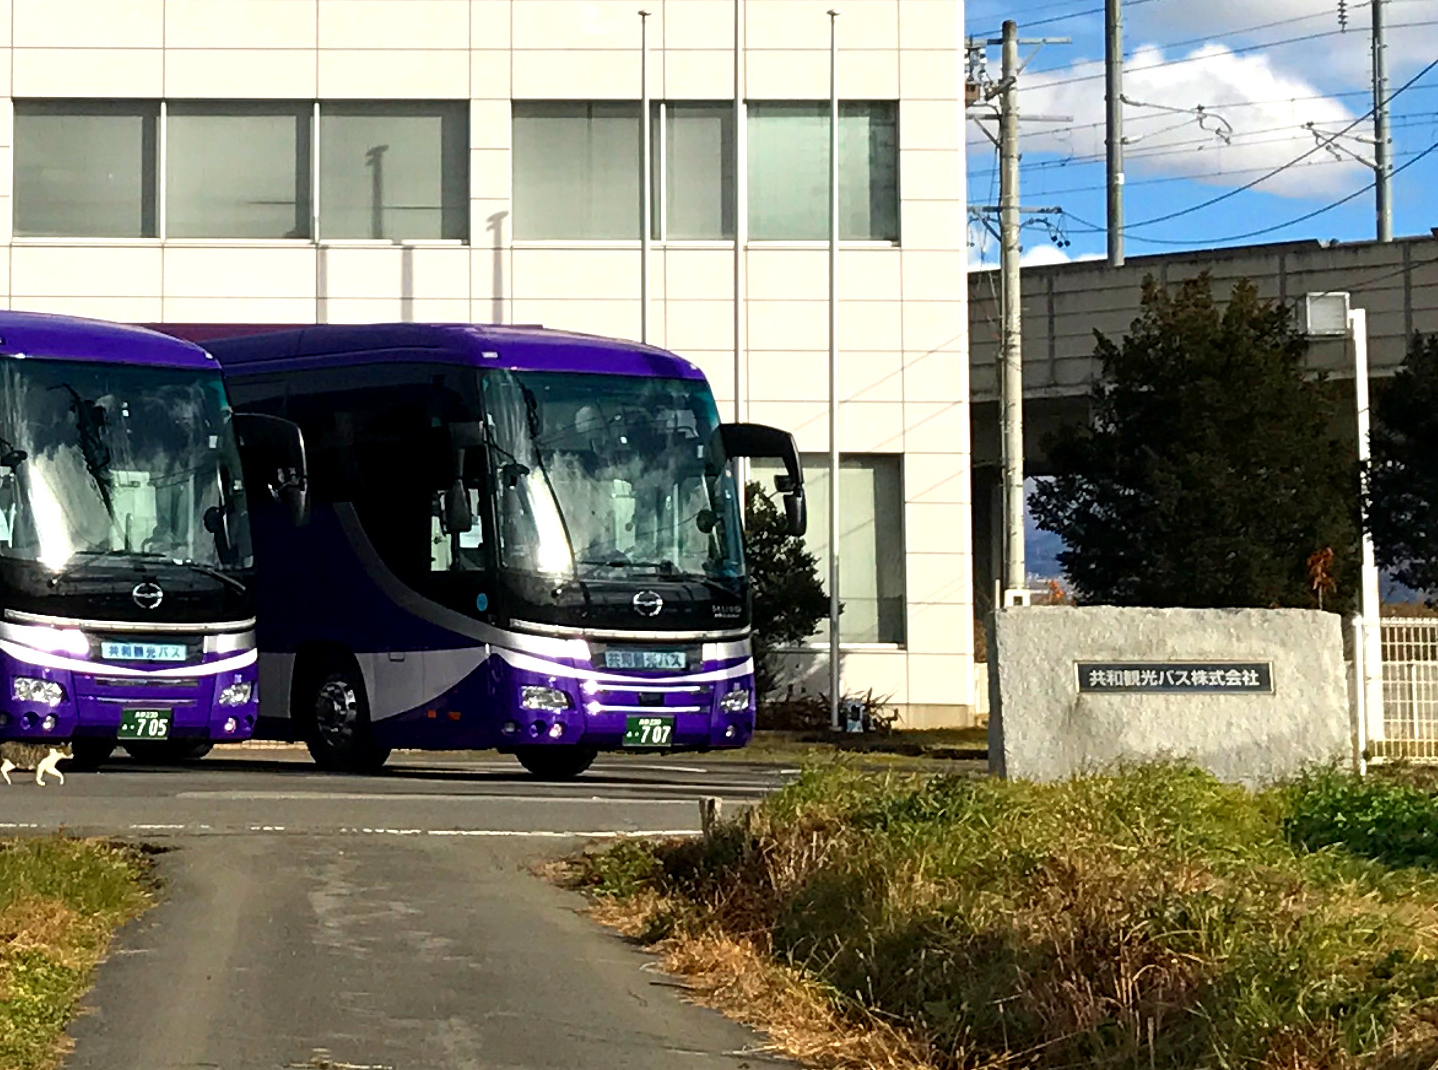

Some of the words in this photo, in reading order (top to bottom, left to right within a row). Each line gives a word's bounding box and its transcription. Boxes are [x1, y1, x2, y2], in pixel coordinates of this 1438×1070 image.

[1089, 670, 1260, 686] 共和観光バス株式会社
[137, 719, 168, 736] 705
[641, 726, 671, 743] 707
